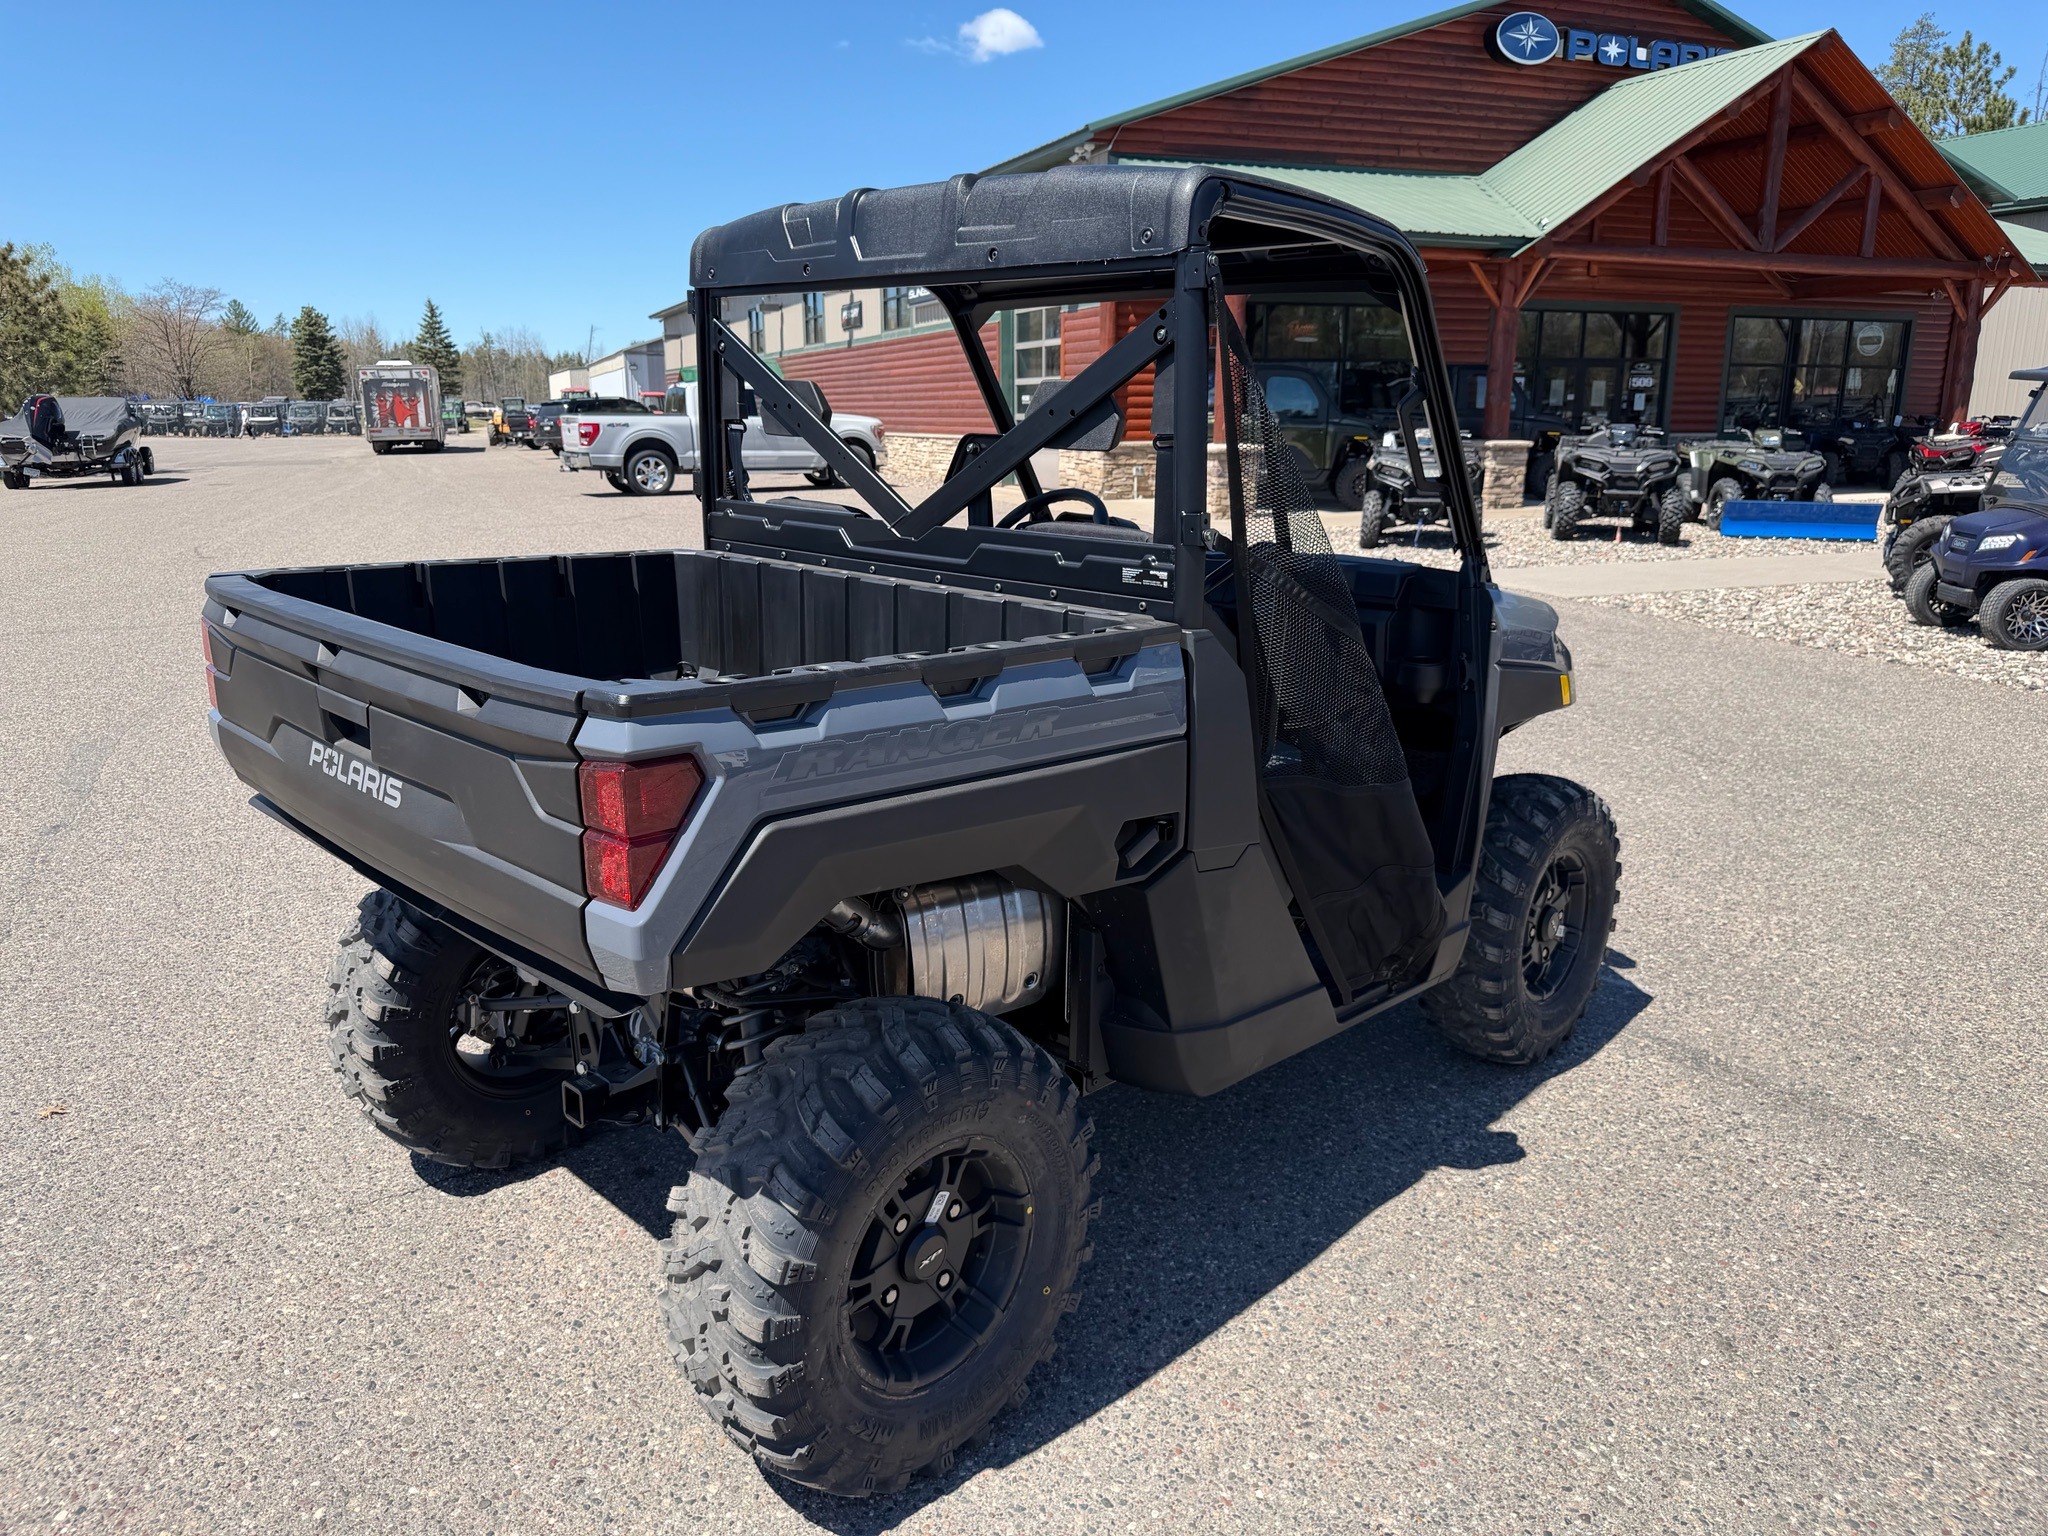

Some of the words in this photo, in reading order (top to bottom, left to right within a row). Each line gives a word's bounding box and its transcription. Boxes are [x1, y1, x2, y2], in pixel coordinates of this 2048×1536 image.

[1563, 28, 1737, 70] POLAR
[1631, 377, 1653, 387] 509
[785, 706, 1061, 782] RANGER
[308, 740, 403, 809] POLARIS
[919, 1248, 943, 1270] XP
